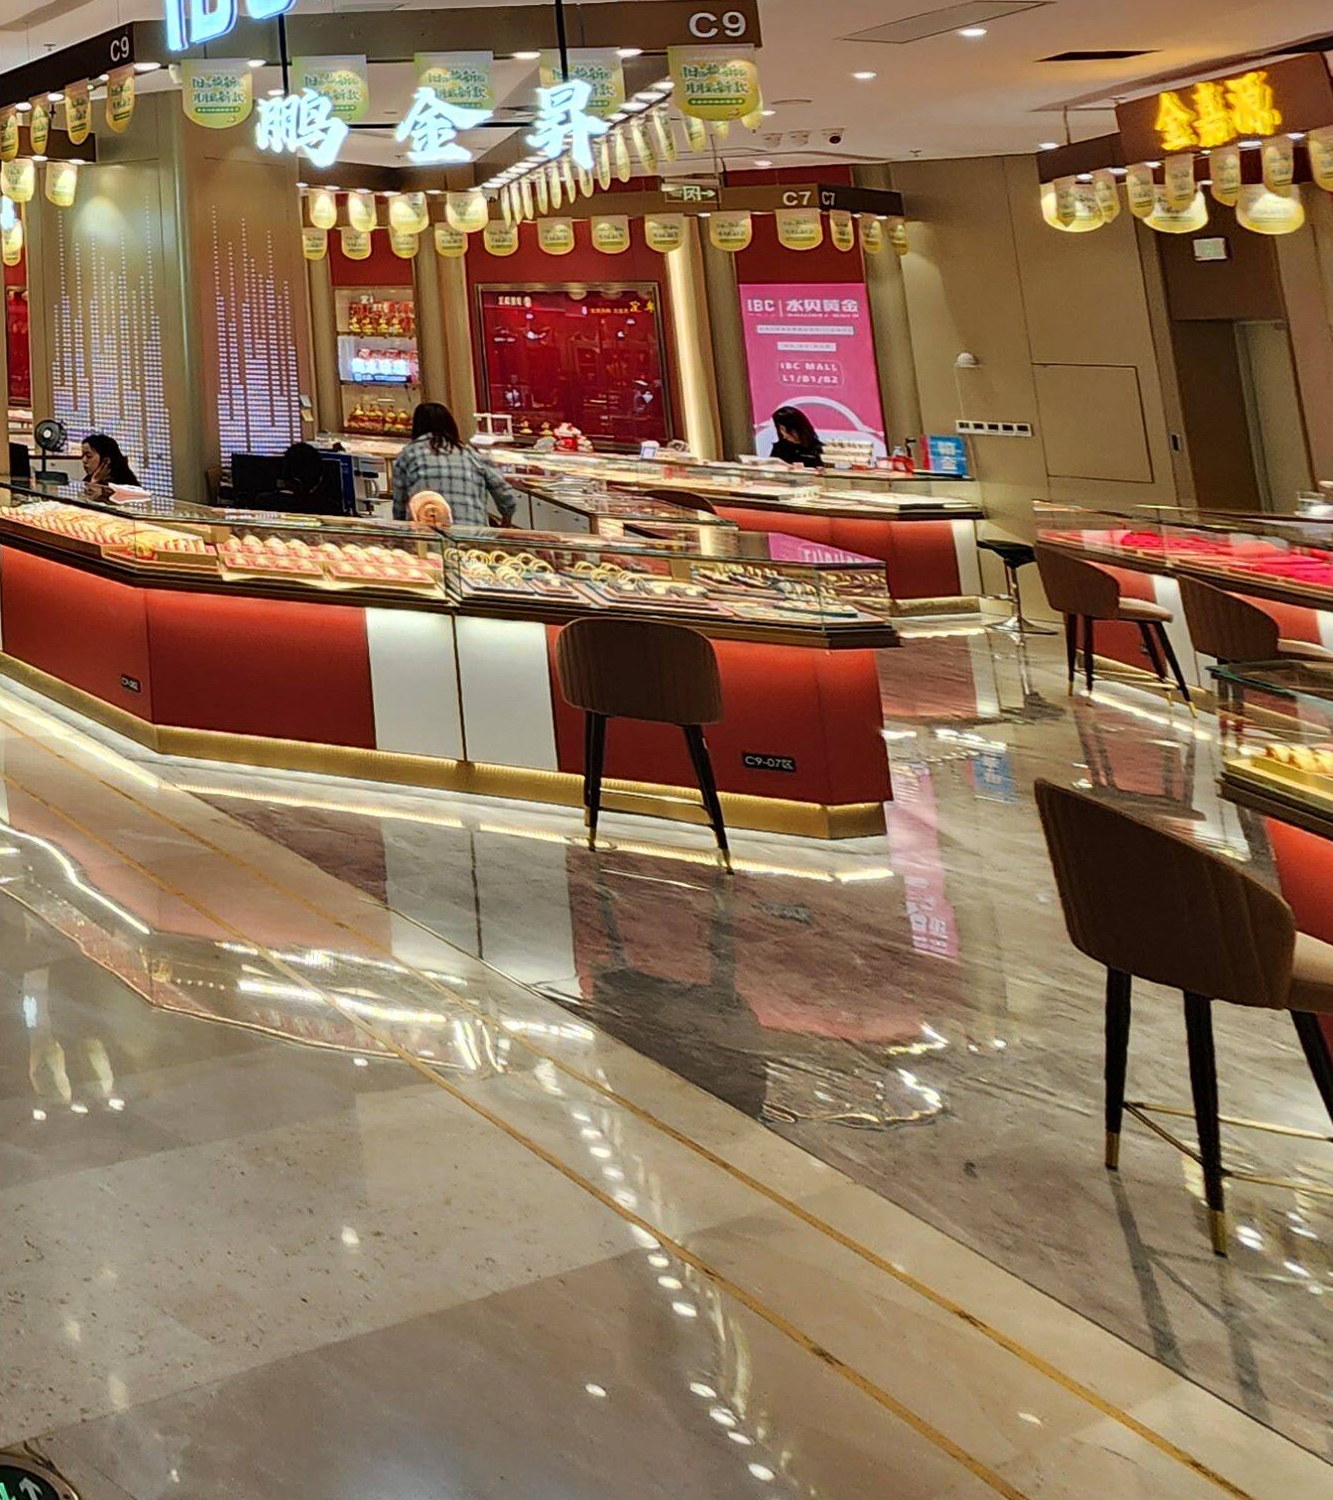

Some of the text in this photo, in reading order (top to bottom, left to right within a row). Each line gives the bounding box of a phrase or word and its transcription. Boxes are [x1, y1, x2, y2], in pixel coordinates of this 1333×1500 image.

[688, 12, 747, 38] C9
[110, 36, 130, 62] C9
[256, 77, 611, 170] 鹏金昇
[783, 191, 811, 206] C7
[822, 191, 835, 206] C7
[748, 299, 860, 313] IBC 水贝黄金
